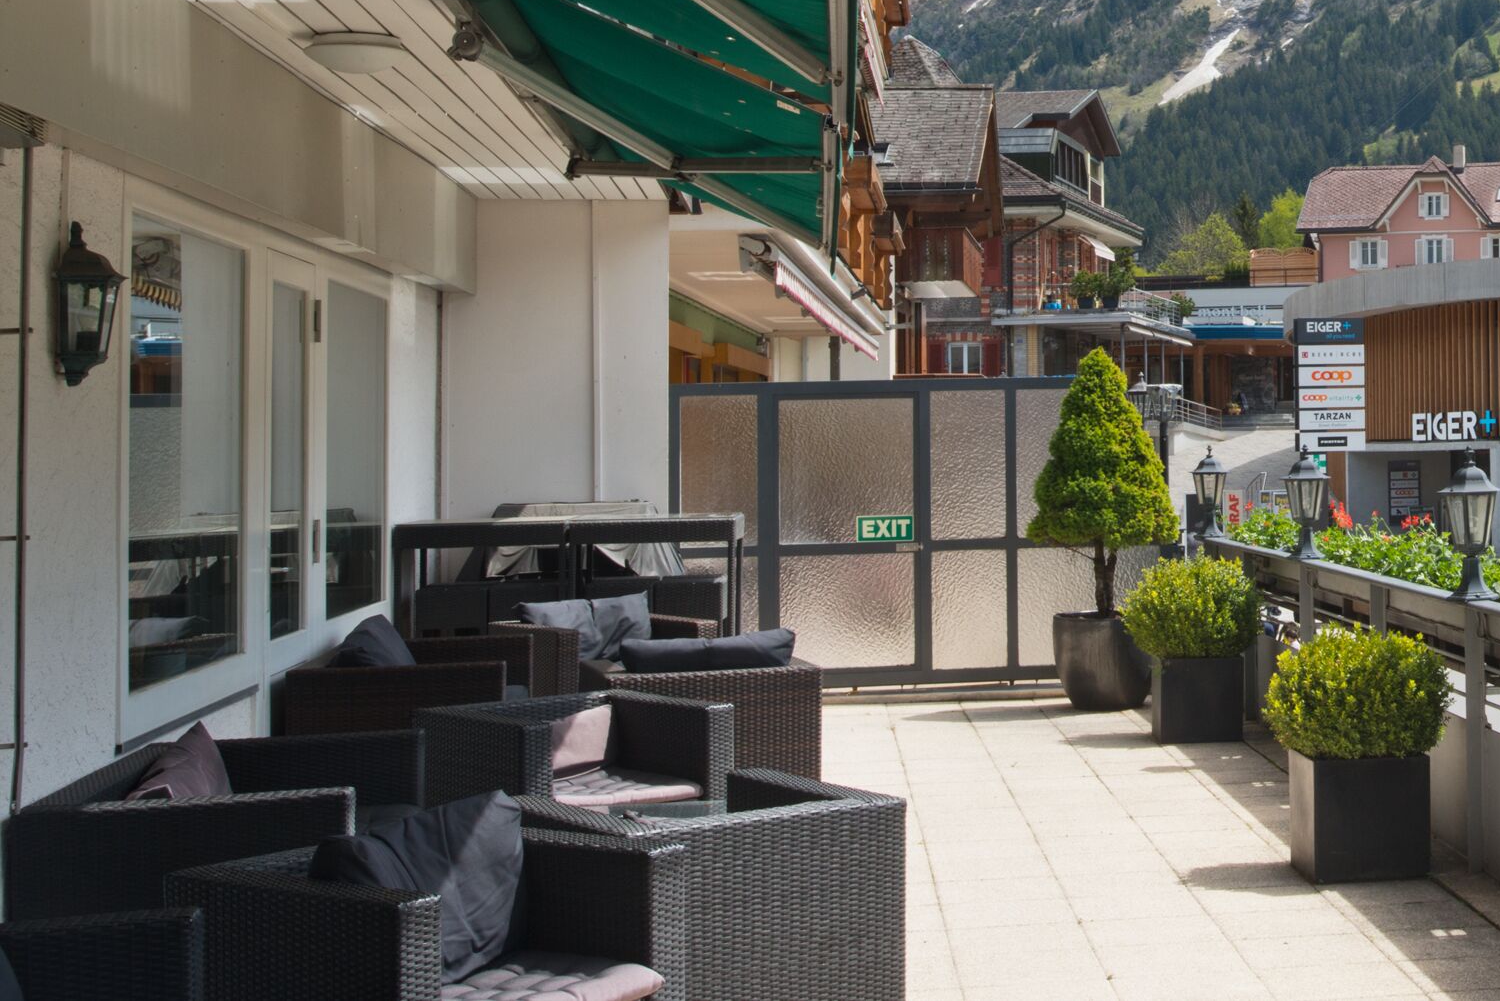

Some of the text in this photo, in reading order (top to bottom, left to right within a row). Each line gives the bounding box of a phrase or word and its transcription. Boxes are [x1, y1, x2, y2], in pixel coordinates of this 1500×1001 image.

[1306, 321, 1352, 333] EIGER+
[1311, 370, 1352, 383] coop
[1302, 394, 1328, 403] coop
[1313, 412, 1352, 420] TARZAN
[862, 519, 910, 538] EXIT
